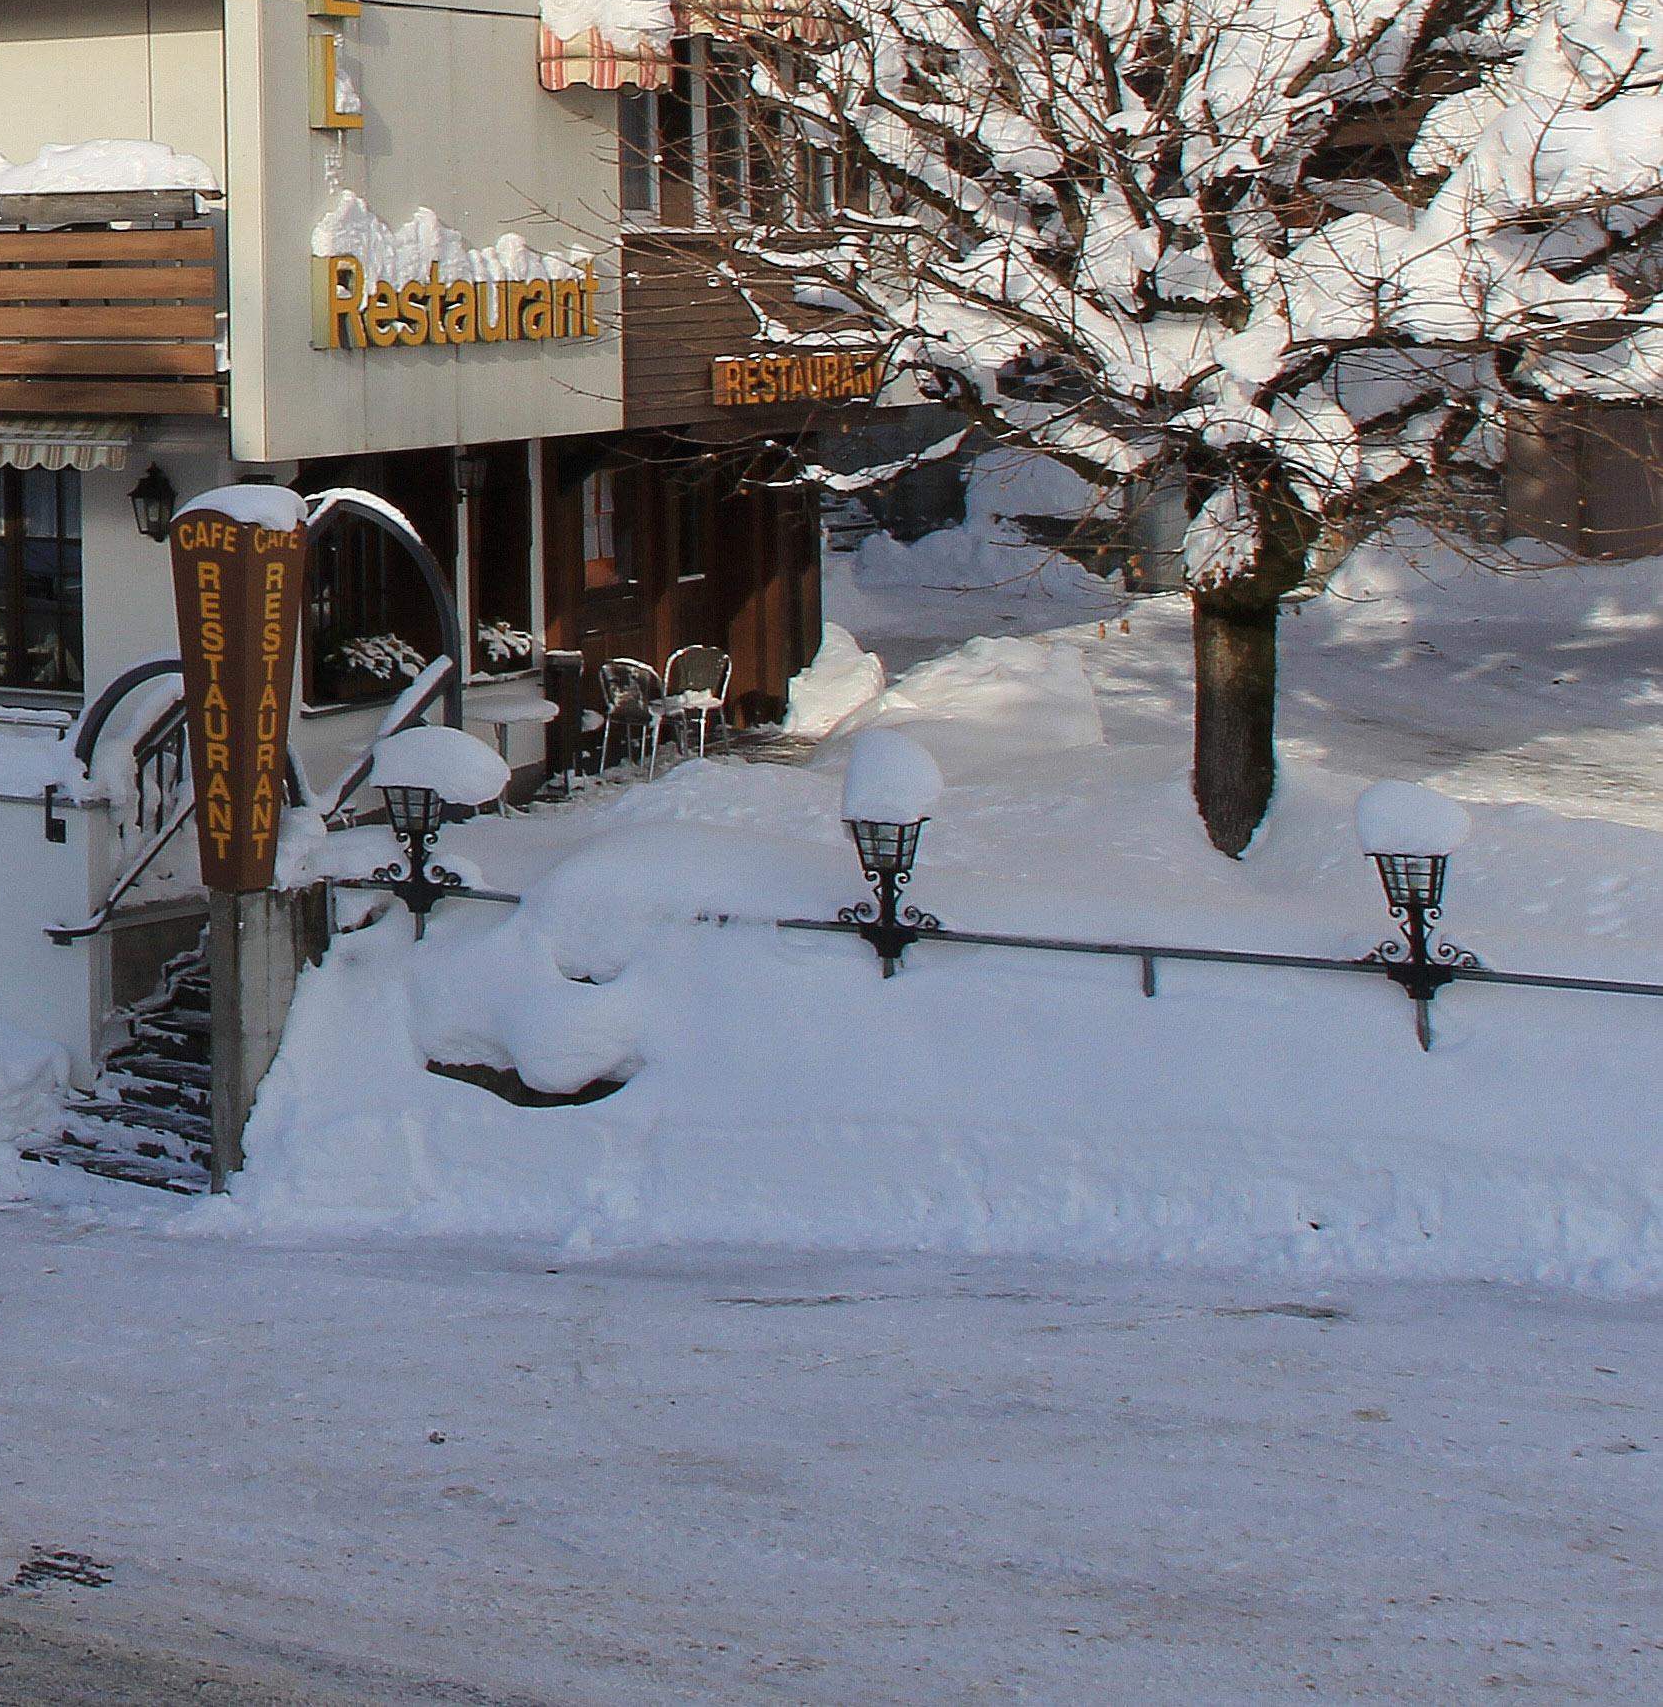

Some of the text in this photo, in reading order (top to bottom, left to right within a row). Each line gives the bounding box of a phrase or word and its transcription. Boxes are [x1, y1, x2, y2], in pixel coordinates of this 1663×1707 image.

[315, 253, 599, 349] Restaurant
[178, 520, 238, 553] CAFE
[197, 561, 232, 860] RESTAURANT
[251, 561, 286, 860] RESTAURANT
